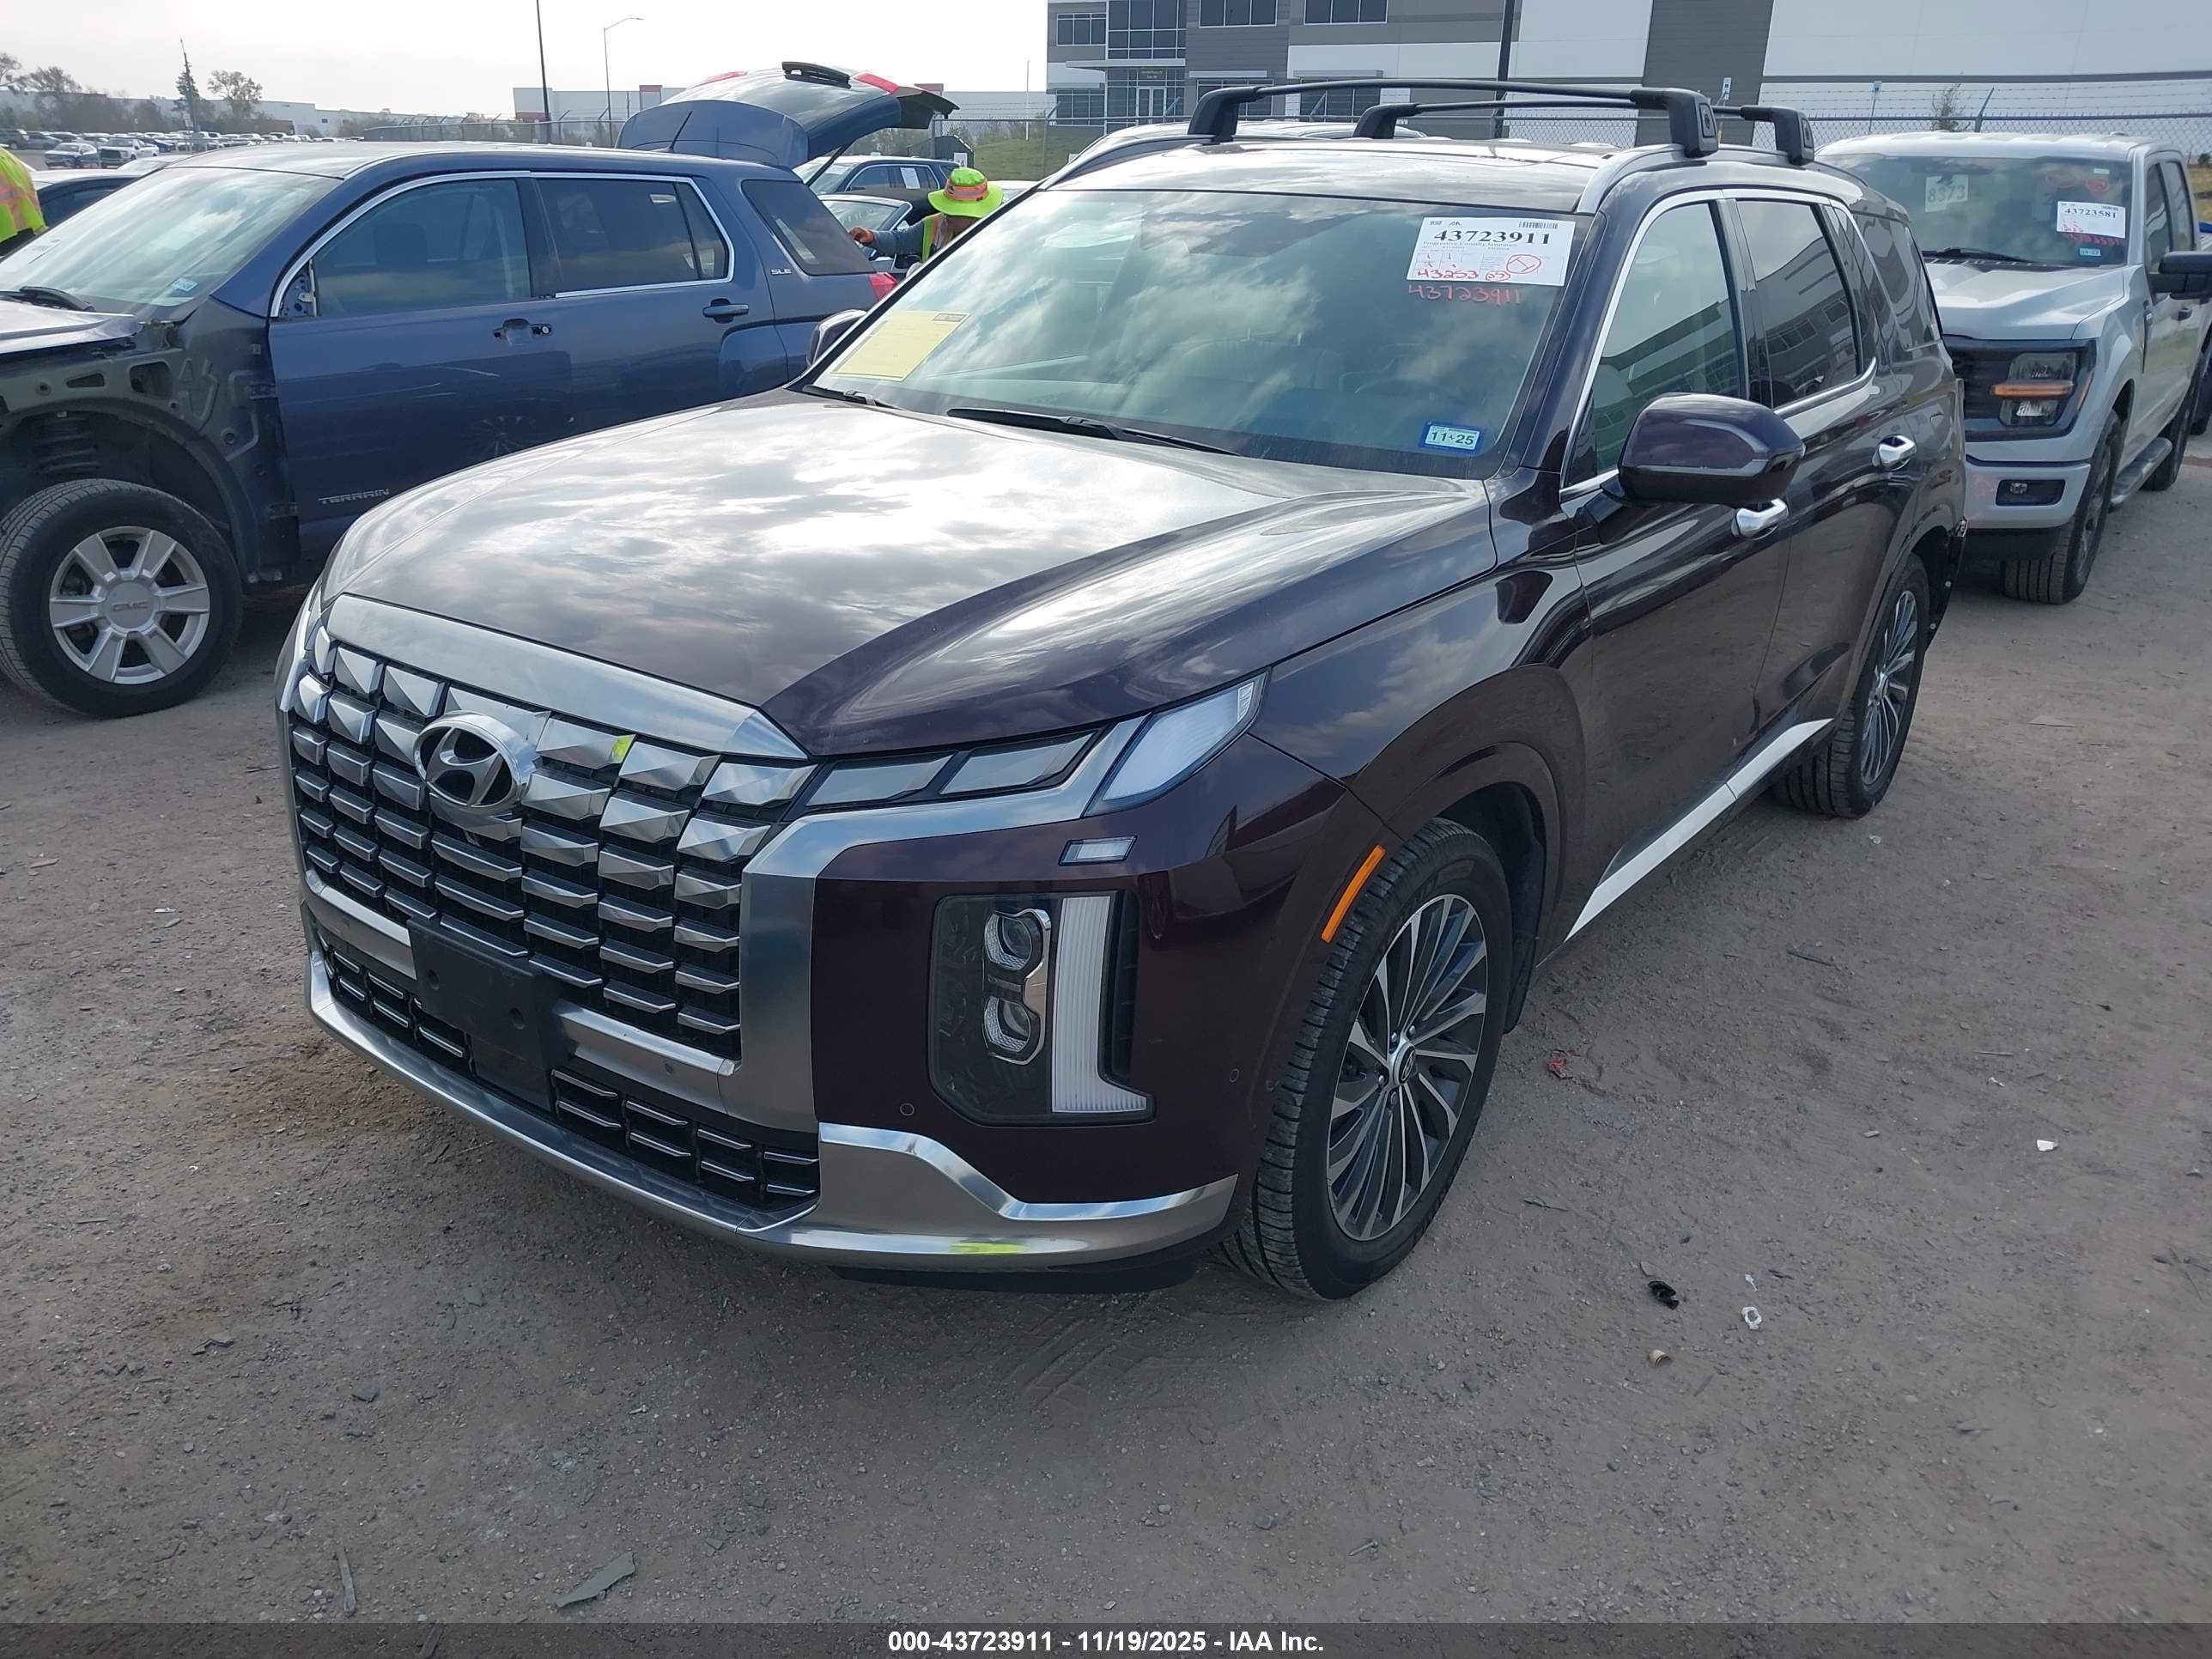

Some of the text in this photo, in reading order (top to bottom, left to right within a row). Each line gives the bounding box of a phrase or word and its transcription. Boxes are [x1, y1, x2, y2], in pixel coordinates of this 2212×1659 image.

[2064, 208, 2117, 219] 43723581
[1434, 229, 1551, 245] 43723911
[318, 489, 390, 505] TERRAIN
